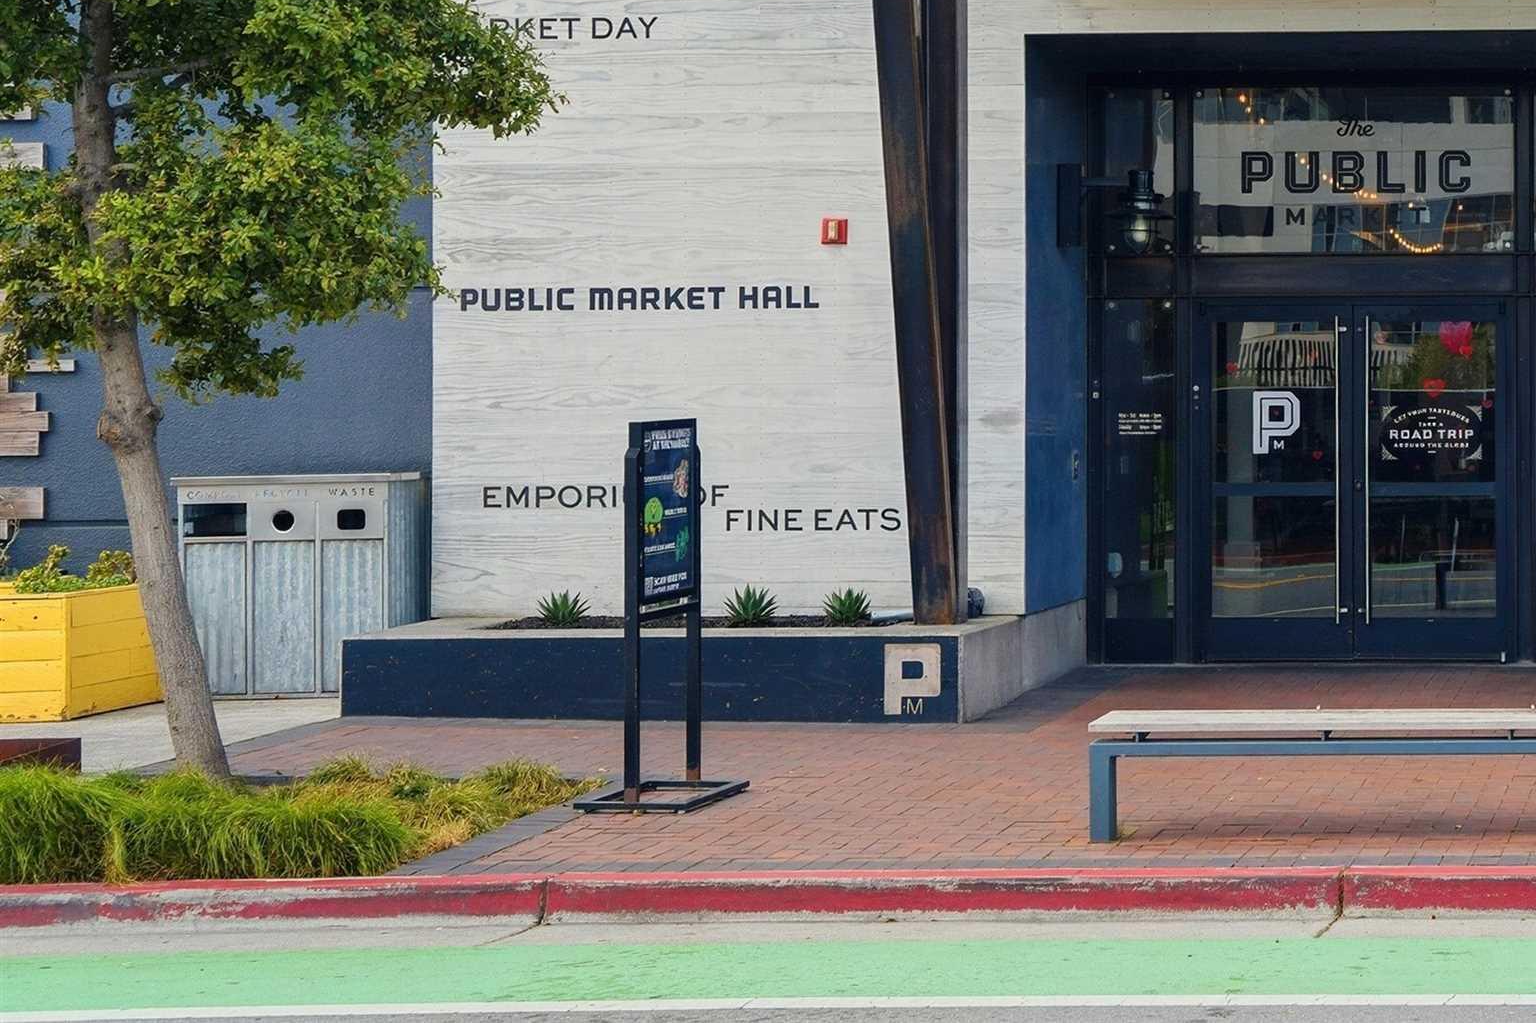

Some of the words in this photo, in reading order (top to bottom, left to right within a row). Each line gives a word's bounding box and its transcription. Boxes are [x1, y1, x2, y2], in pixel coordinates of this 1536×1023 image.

[591, 16, 659, 40] DAY
[1336, 118, 1376, 138] The
[1240, 149, 1472, 195] PUBLIC
[459, 287, 576, 312] PUBLIC
[588, 286, 726, 311] MARKET
[738, 285, 820, 310] HALL
[1389, 429, 1433, 440] ROAD
[1437, 429, 1474, 440] TRIP
[327, 486, 376, 497] WASTE
[481, 484, 626, 509] EMPORI
[724, 508, 803, 532] FINE
[813, 507, 902, 531] EATS
